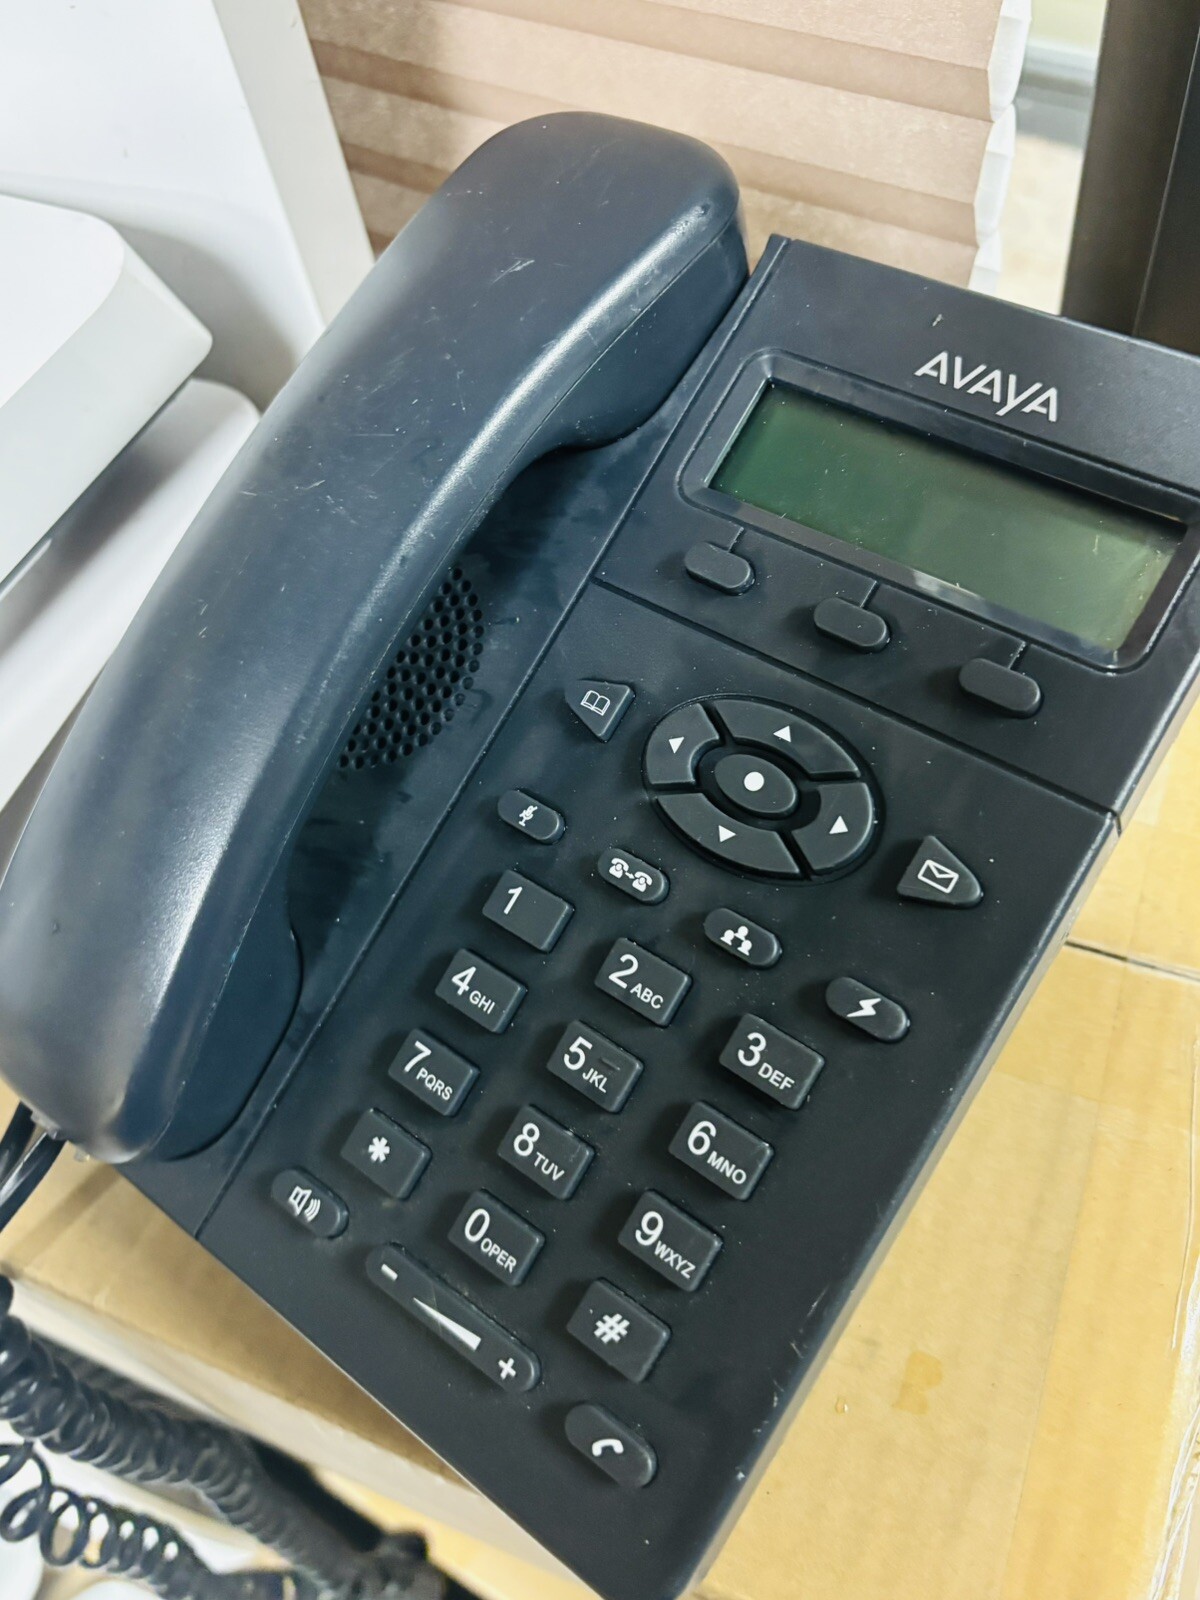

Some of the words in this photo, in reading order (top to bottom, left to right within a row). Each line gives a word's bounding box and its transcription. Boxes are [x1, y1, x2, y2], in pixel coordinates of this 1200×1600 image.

[914, 351, 1058, 423] AVAYA
[503, 886, 523, 915] 1
[451, 966, 475, 997] 4
[469, 990, 496, 1015] GHI
[608, 953, 638, 993] 2
[630, 984, 664, 1010] ABC
[403, 1040, 435, 1079] 7
[415, 1067, 453, 1101] PQRS
[563, 1035, 592, 1071] 5
[581, 1067, 608, 1094] JKL
[737, 1032, 765, 1071] 3
[757, 1062, 795, 1091] DEF
[513, 1122, 541, 1161] 8
[533, 1151, 565, 1181] TUV
[687, 1120, 715, 1157] 6
[706, 1150, 747, 1185] MNO
[464, 1208, 490, 1245] 0
[479, 1237, 518, 1274] OPER
[635, 1210, 665, 1249] 9
[653, 1243, 696, 1279] WXYZ
